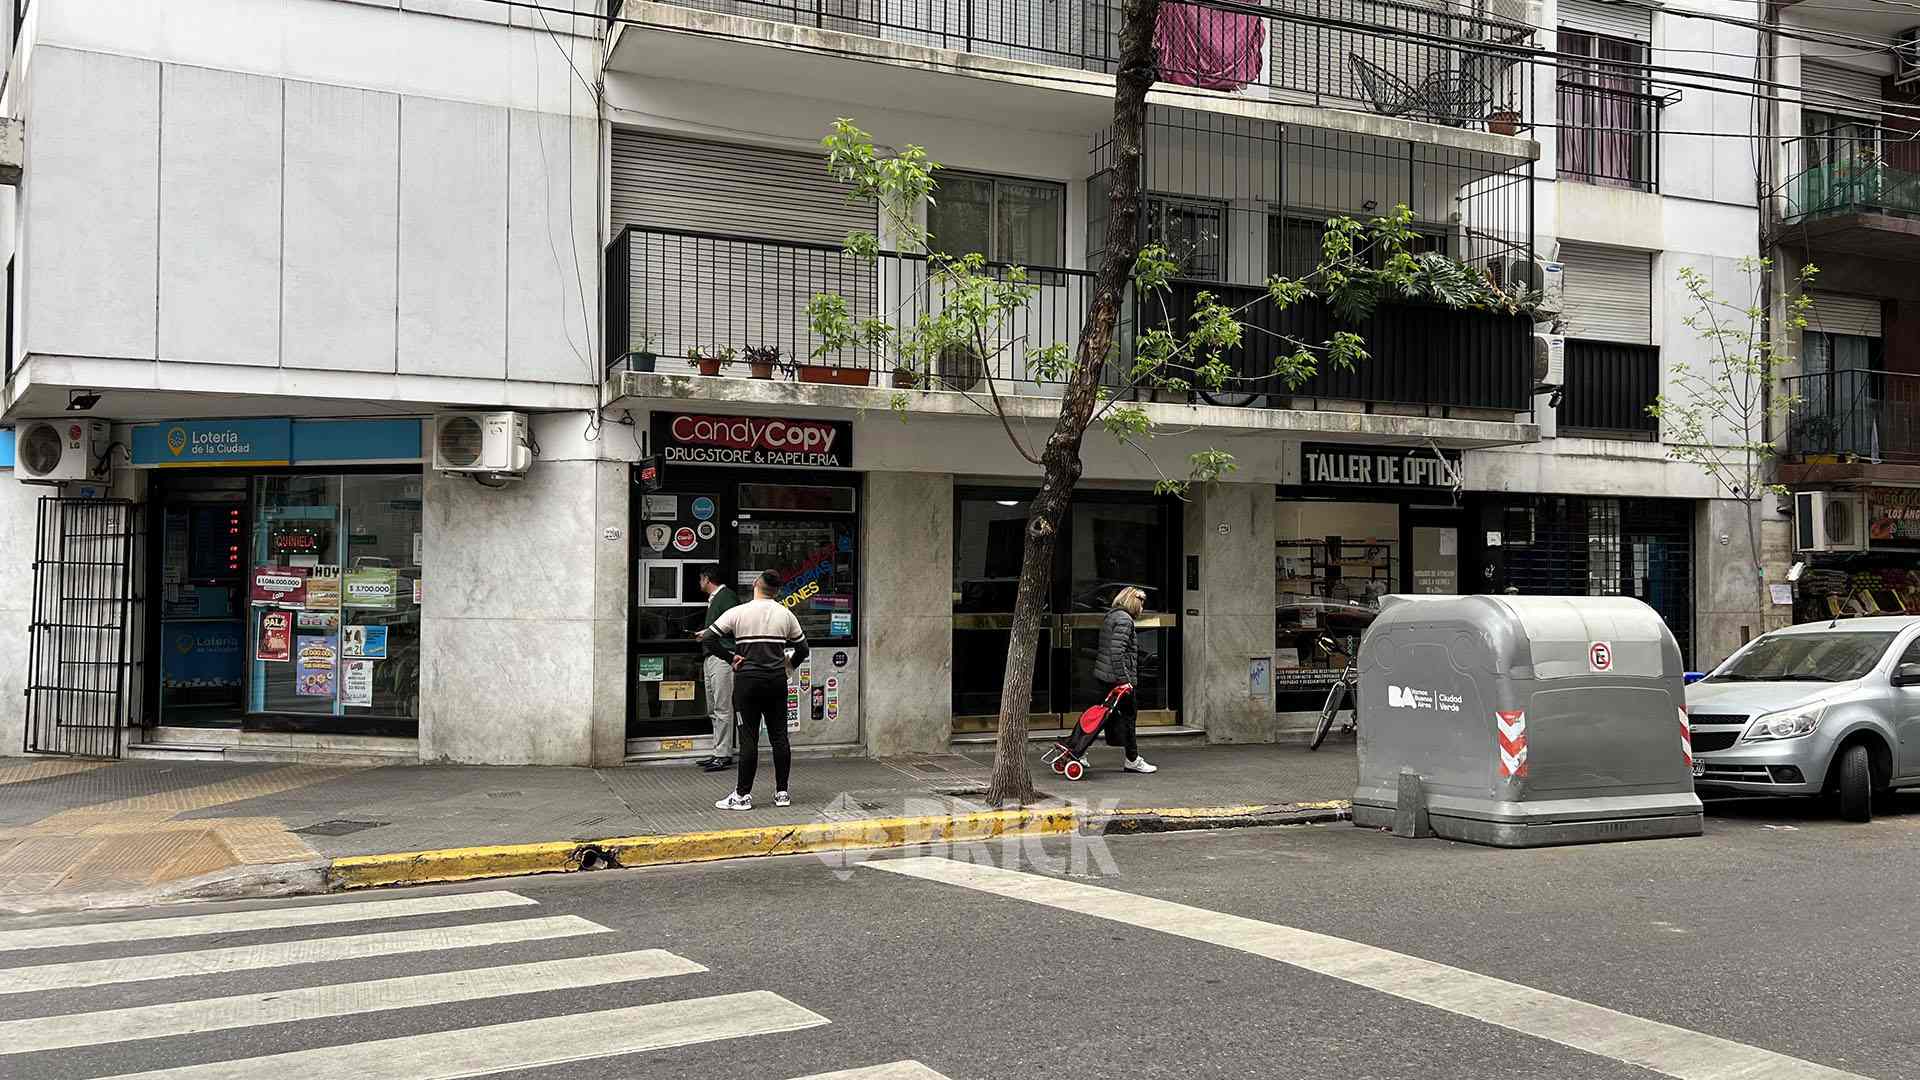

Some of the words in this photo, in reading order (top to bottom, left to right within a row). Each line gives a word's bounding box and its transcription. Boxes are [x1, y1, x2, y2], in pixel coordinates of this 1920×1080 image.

[192, 430, 238, 444] Lotería
[672, 416, 836, 452] CandyCopy
[191, 445, 203, 454] de
[206, 443, 214, 454] la
[217, 443, 250, 454] Ciudad
[665, 447, 751, 463] DRUGSTORE
[755, 452, 765, 464] &
[767, 451, 839, 466] PAPELERIA
[1305, 453, 1372, 483] TALLER
[1376, 456, 1400, 484] DE
[315, 566, 340, 578] HOY
[1388, 685, 1417, 709] BA
[1439, 694, 1462, 703] Ciudad
[1440, 702, 1460, 712] Verde
